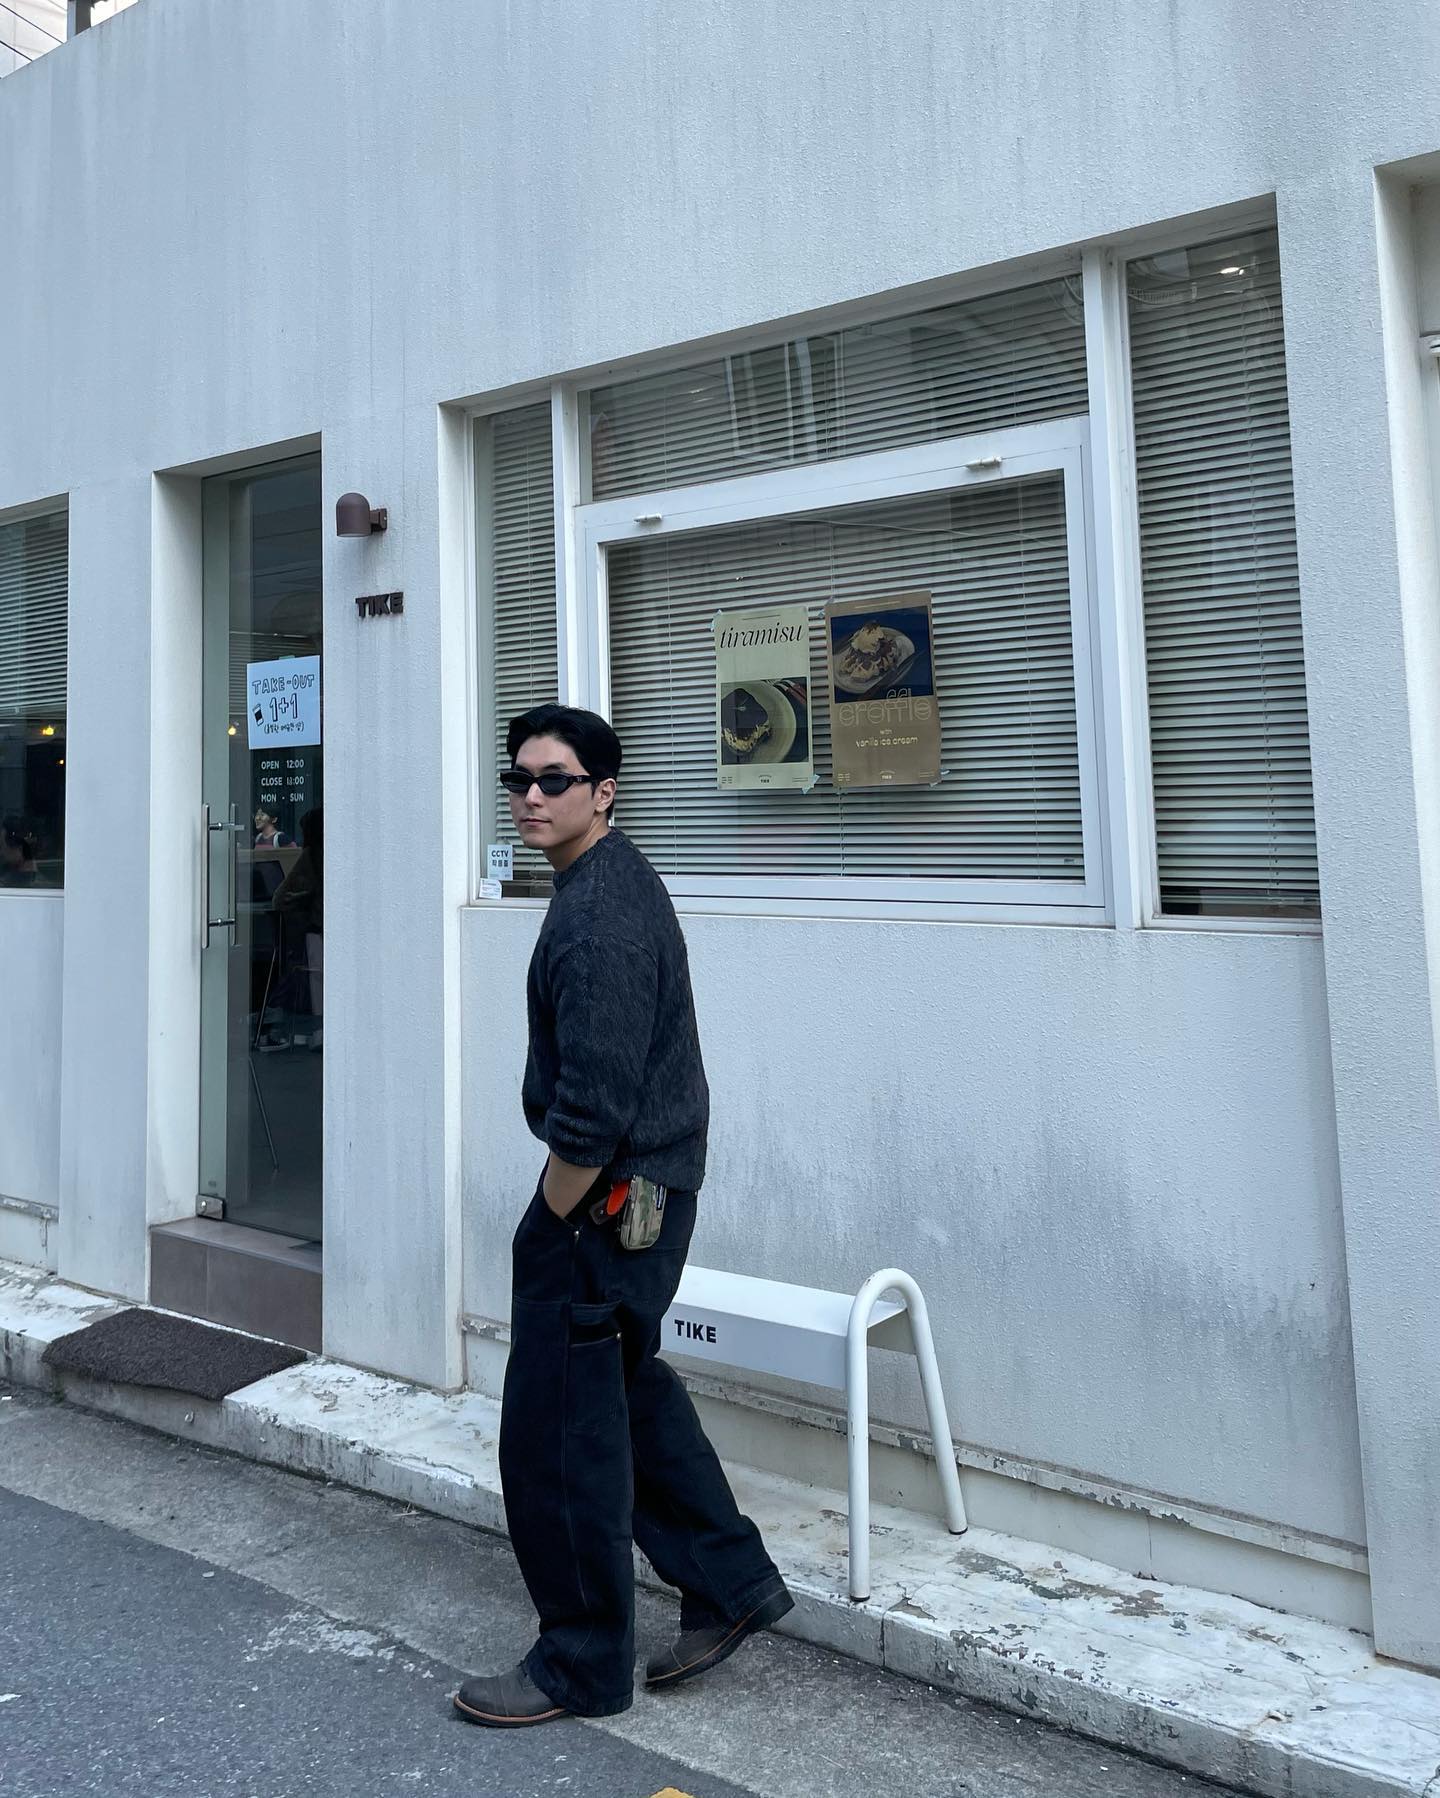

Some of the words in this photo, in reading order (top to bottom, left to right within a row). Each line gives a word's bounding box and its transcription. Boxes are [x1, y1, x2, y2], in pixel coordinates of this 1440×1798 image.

[355, 592, 403, 618] TIKE
[720, 622, 803, 648] tiramisu
[252, 674, 315, 695] TAKE-OUT
[269, 692, 299, 722] 1+1
[261, 760, 280, 770] OPEN
[261, 777, 283, 787] CLOSE
[261, 793, 277, 803] MON
[290, 792, 304, 802] SUN
[491, 850, 509, 858] CCTV
[674, 1319, 717, 1344] TIKE
